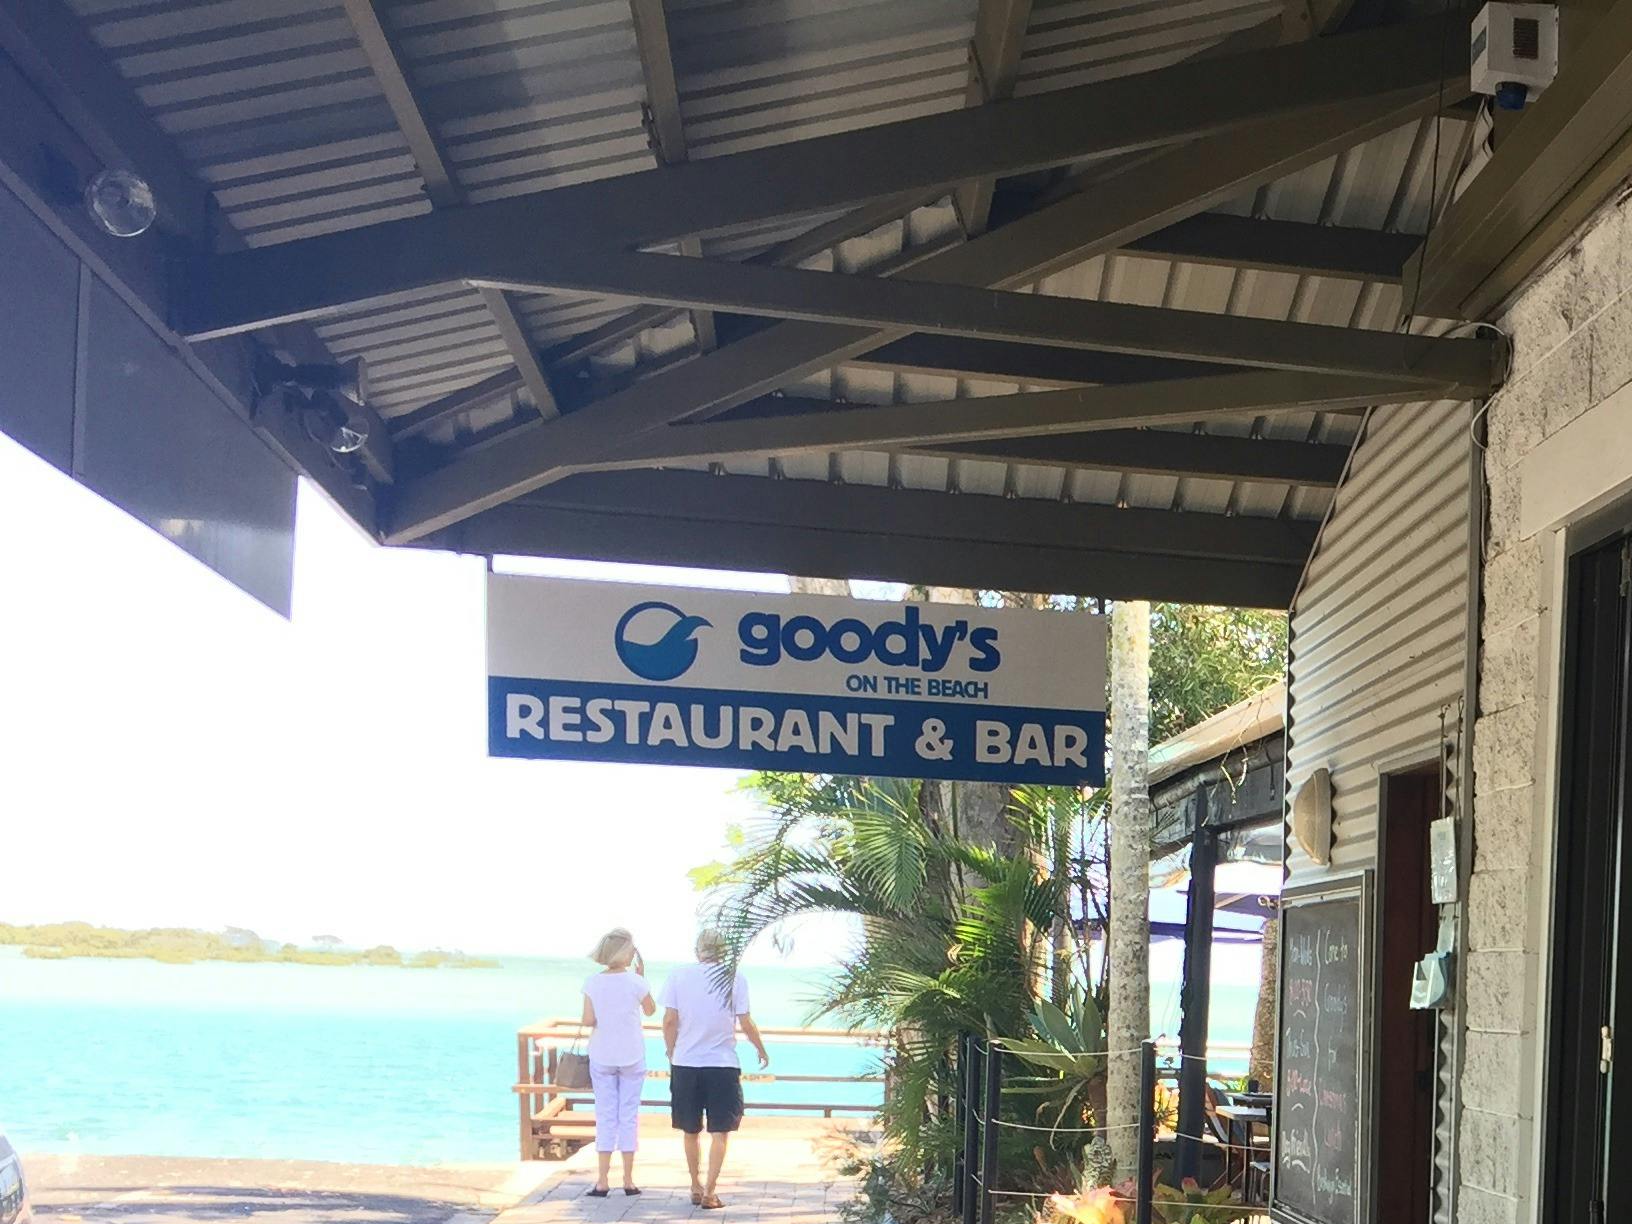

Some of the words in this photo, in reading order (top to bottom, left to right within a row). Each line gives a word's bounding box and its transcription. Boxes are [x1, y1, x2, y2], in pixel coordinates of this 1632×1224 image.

[738, 606, 1001, 672] goody's
[846, 674, 877, 694] ON
[883, 676, 922, 696] THE
[928, 678, 989, 699] BEACH
[506, 693, 894, 758] RESTAURANT
[915, 717, 953, 761] &
[975, 719, 1088, 768] BAR
